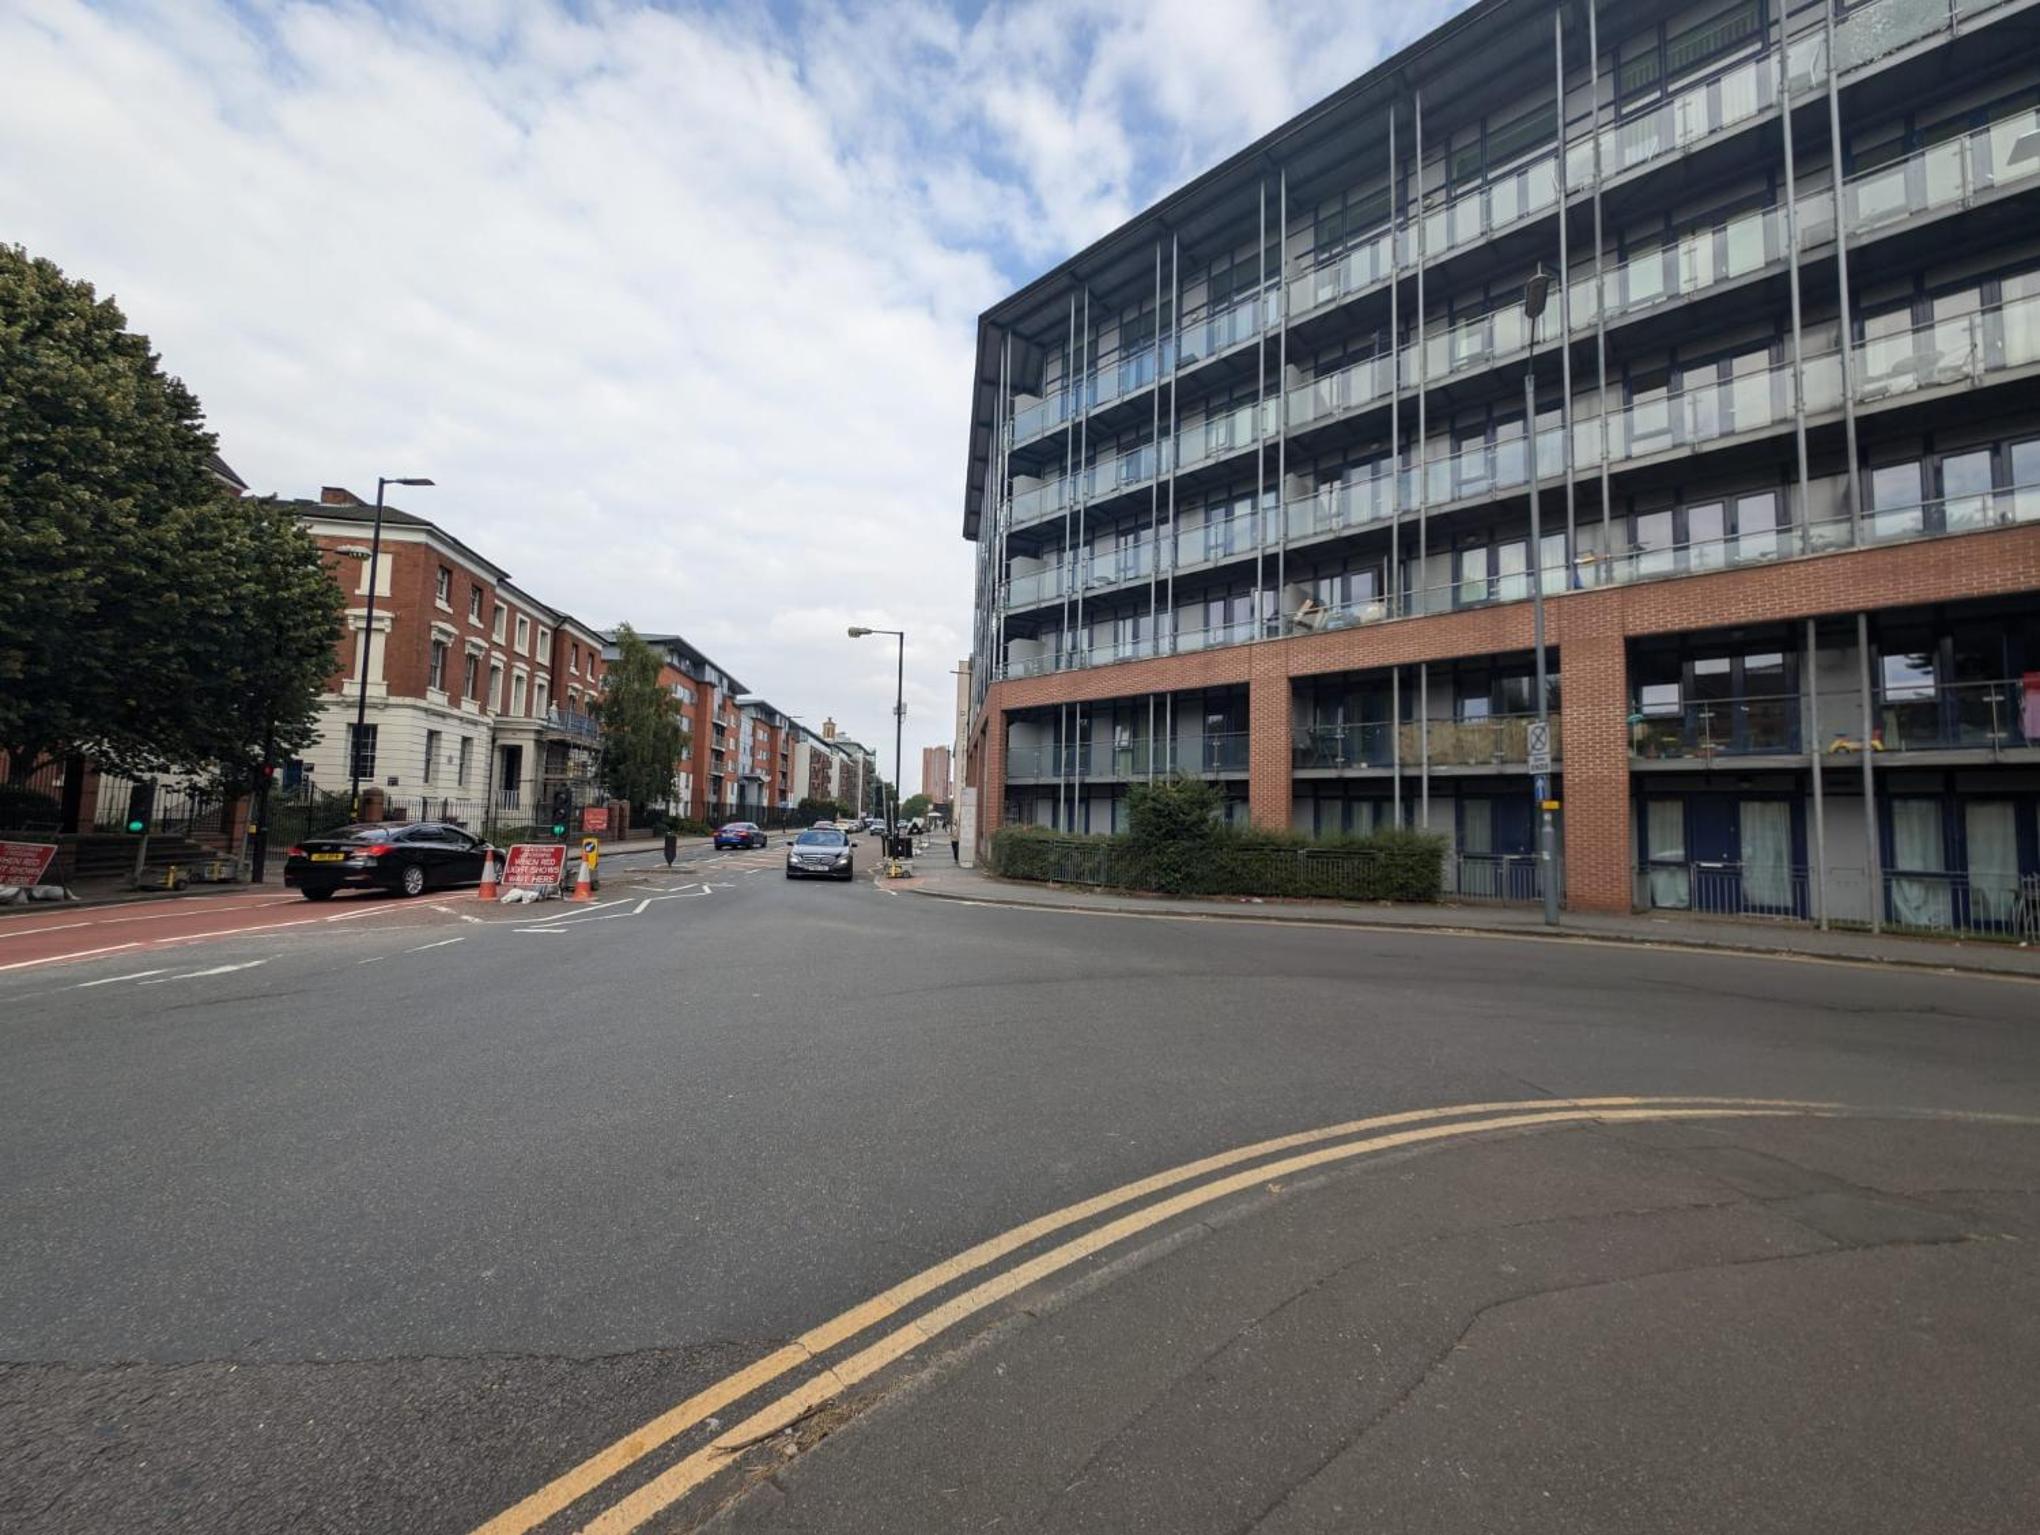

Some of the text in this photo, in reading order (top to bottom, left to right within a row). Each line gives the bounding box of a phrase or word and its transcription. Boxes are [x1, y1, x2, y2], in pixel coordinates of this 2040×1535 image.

[514, 858, 556, 866] WHEN RED
[530, 866, 560, 874] SHOWS
[531, 875, 556, 883] HERE
